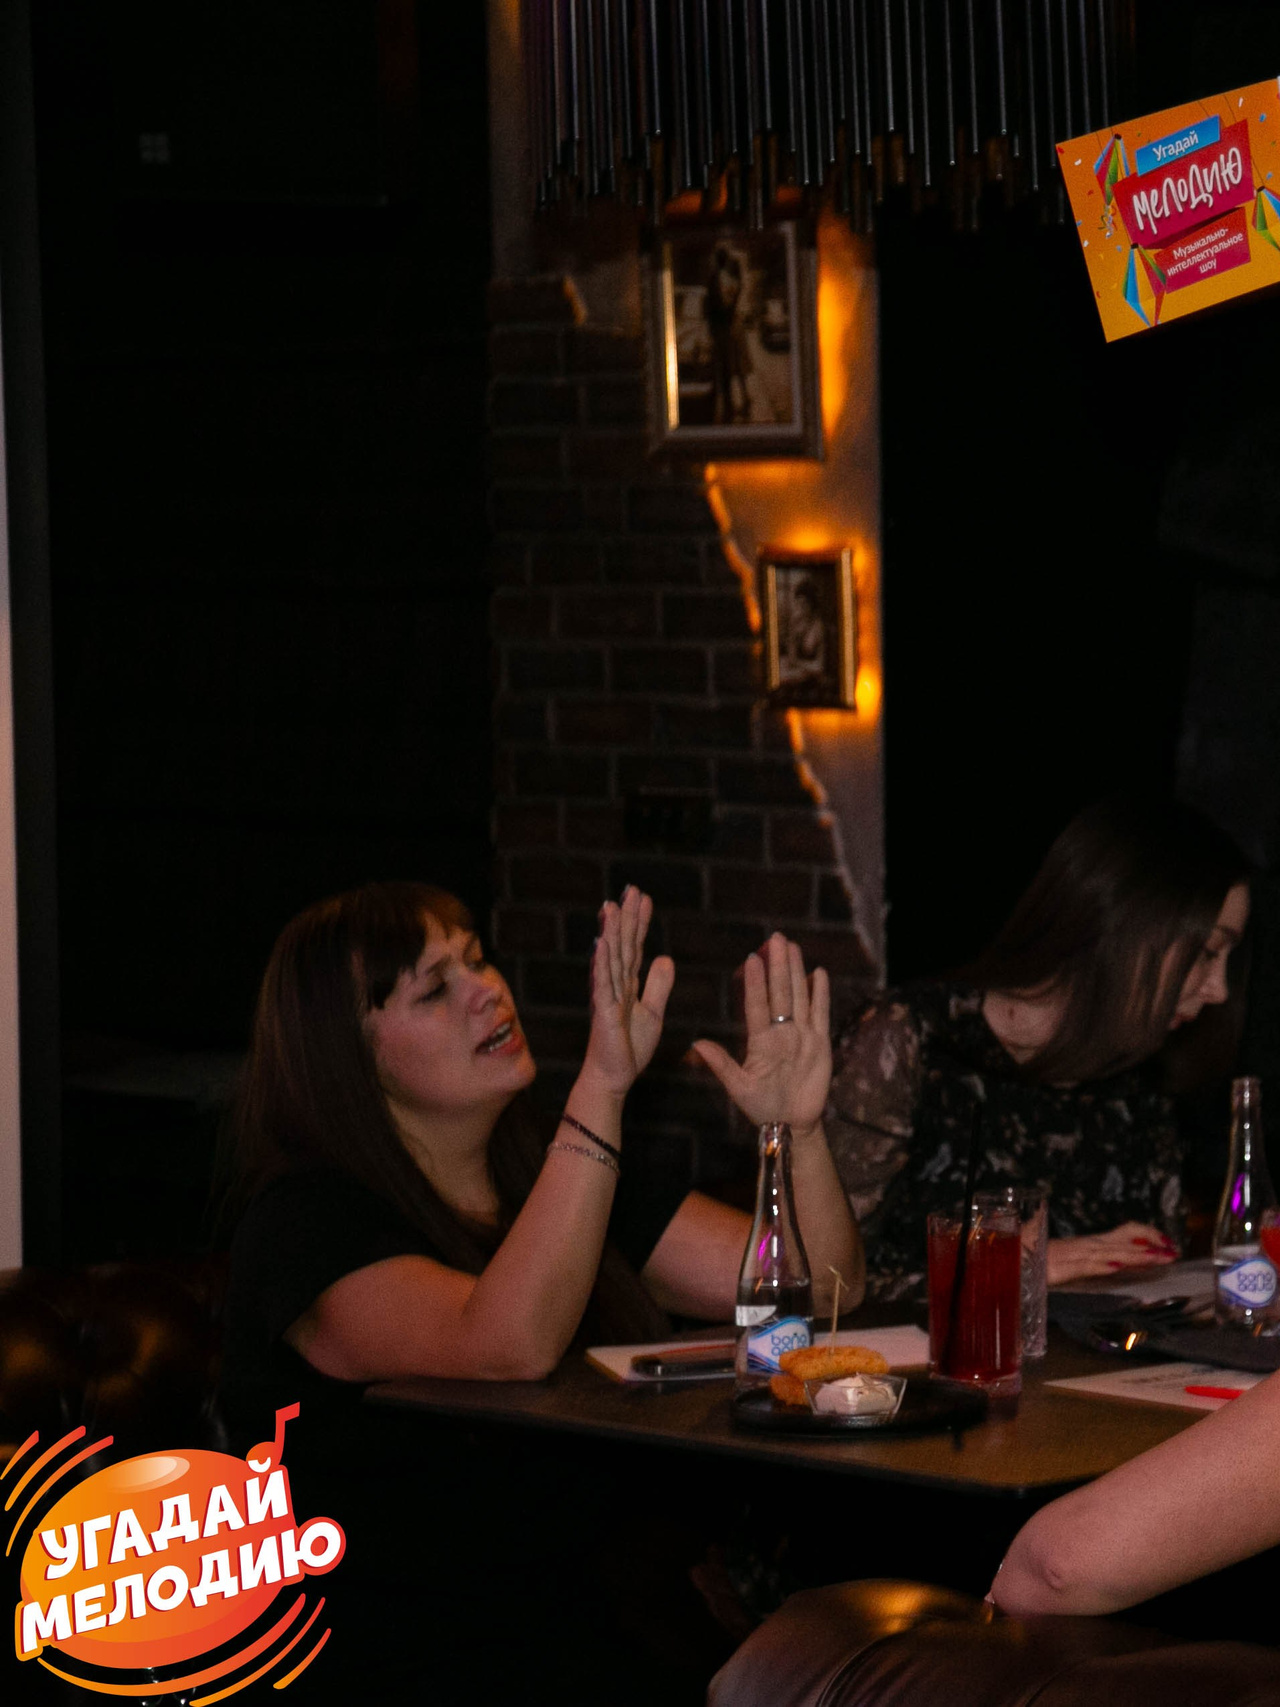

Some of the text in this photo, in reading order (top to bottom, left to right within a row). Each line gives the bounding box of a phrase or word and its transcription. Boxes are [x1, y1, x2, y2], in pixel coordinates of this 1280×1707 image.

[1153, 131, 1198, 161] Угадай
[1167, 235, 1243, 276] интеллектуальное
[1173, 228, 1228, 258] Музыкально-
[1200, 257, 1216, 273] шоу
